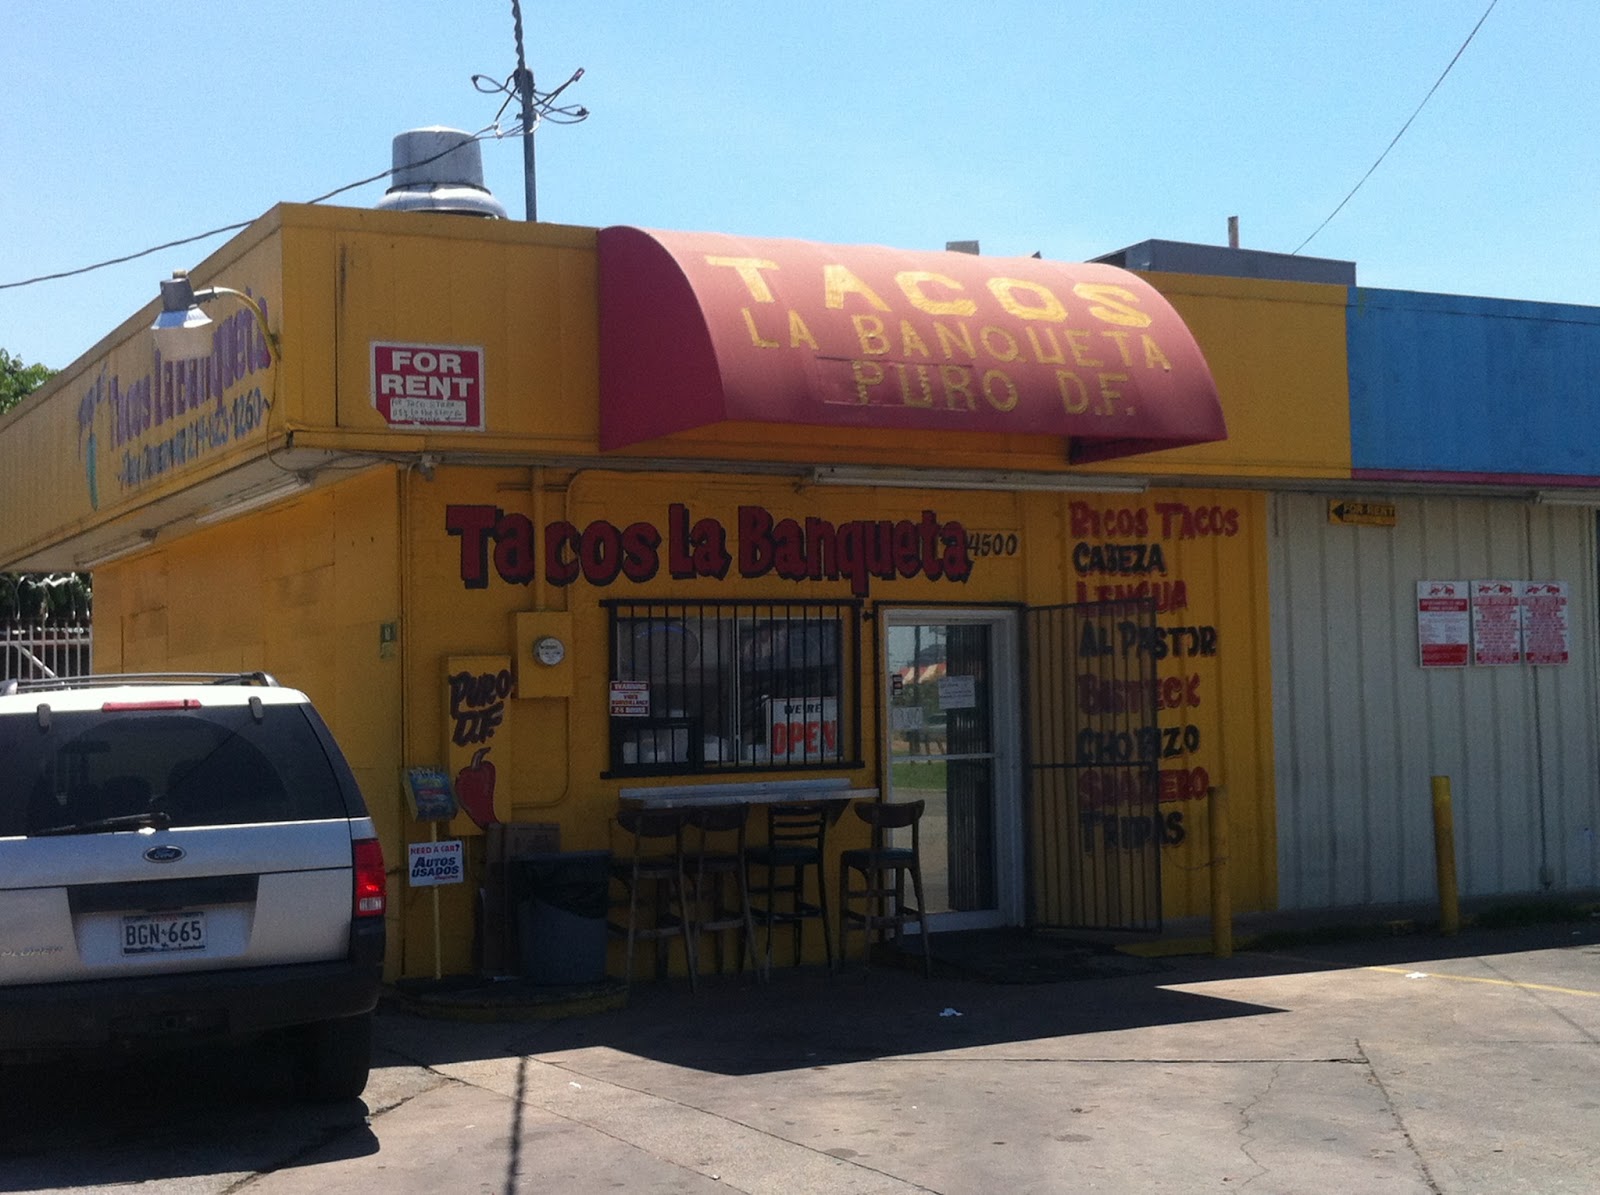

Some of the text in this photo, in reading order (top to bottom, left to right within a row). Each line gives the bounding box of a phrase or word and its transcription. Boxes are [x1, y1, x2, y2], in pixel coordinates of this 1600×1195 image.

[704, 254, 1153, 328] TACOS
[741, 307, 1173, 372] LA BANQUETA
[391, 350, 462, 375] FOR
[380, 373, 474, 399] RENT
[851, 360, 1019, 412] PURO
[446, 503, 974, 598] Tacos La Banqueta
[967, 533, 1019, 557] 4500
[1073, 541, 1168, 576] CABEZA
[784, 703, 822, 714] WERE
[772, 720, 837, 756] OPEN
[411, 865, 459, 878] USADOS
[125, 920, 202, 946] BGN 665
